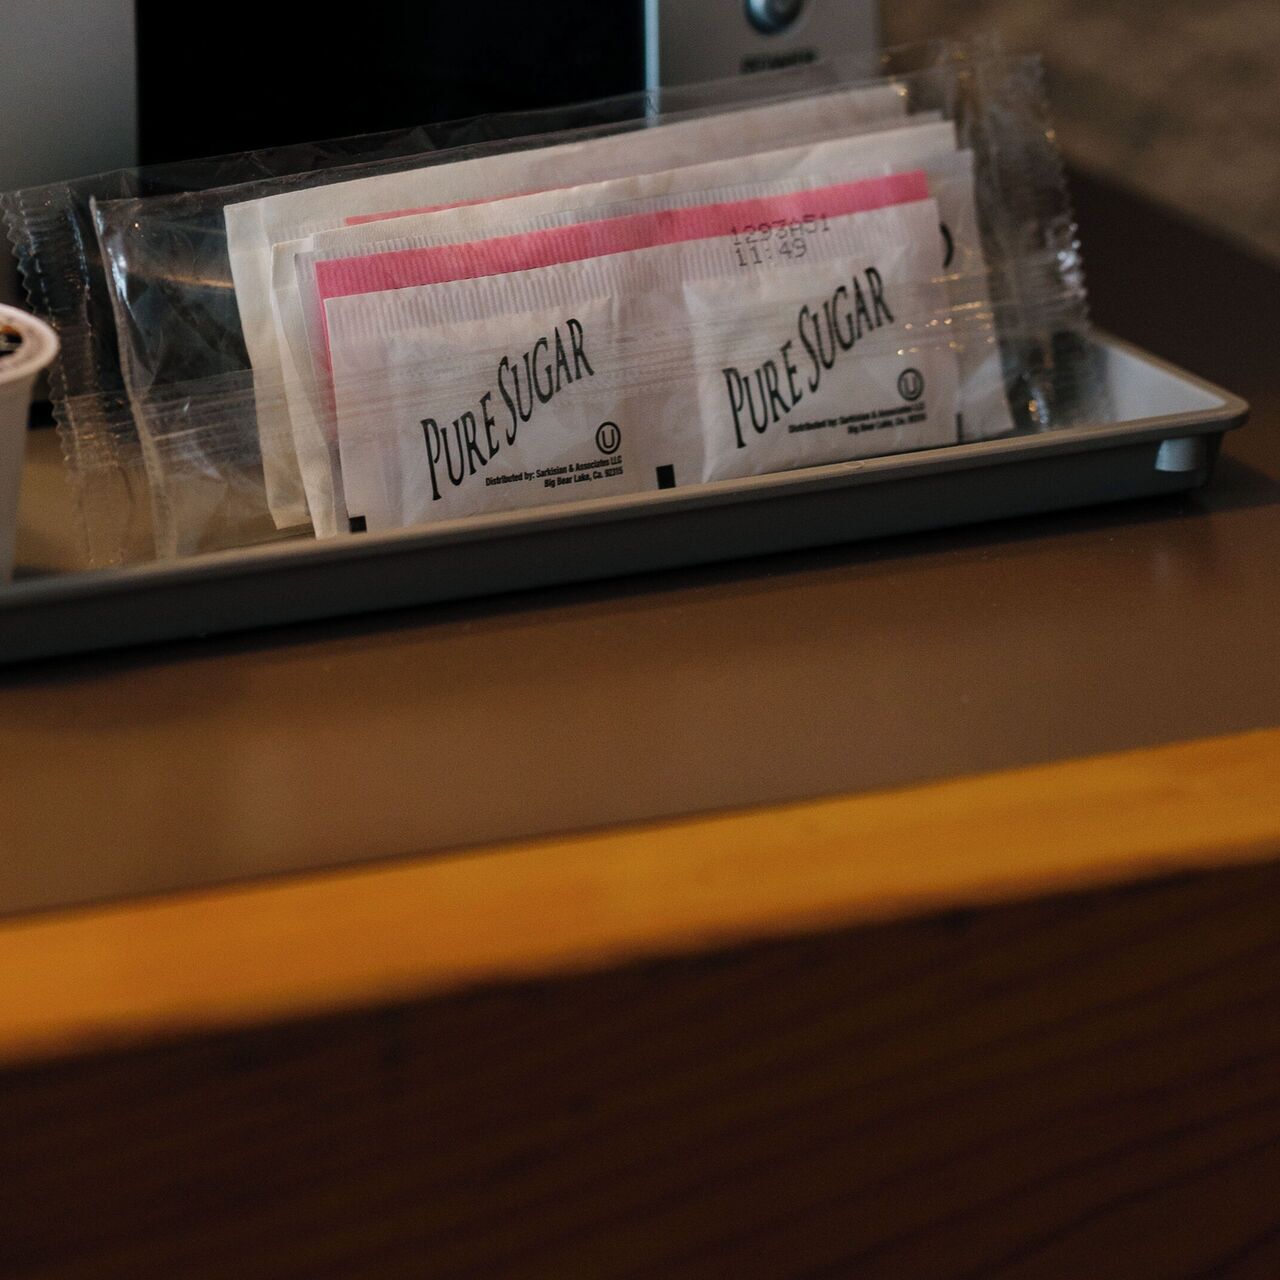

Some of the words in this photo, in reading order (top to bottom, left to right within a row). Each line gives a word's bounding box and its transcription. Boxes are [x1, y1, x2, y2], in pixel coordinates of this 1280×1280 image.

[735, 237, 808, 267] 11:49
[722, 340, 803, 448] PURE
[798, 266, 895, 393] SUGAR
[420, 391, 500, 500] PURE
[497, 318, 595, 446] SUGAR
[485, 473, 523, 487] Distributed
[524, 471, 535, 482] by:
[568, 463, 575, 473] &
[575, 458, 610, 471] Associates
[610, 455, 622, 466] LLC
[543, 478, 556, 488] Big
[557, 476, 572, 485] Bear
[573, 474, 592, 483] Lake,
